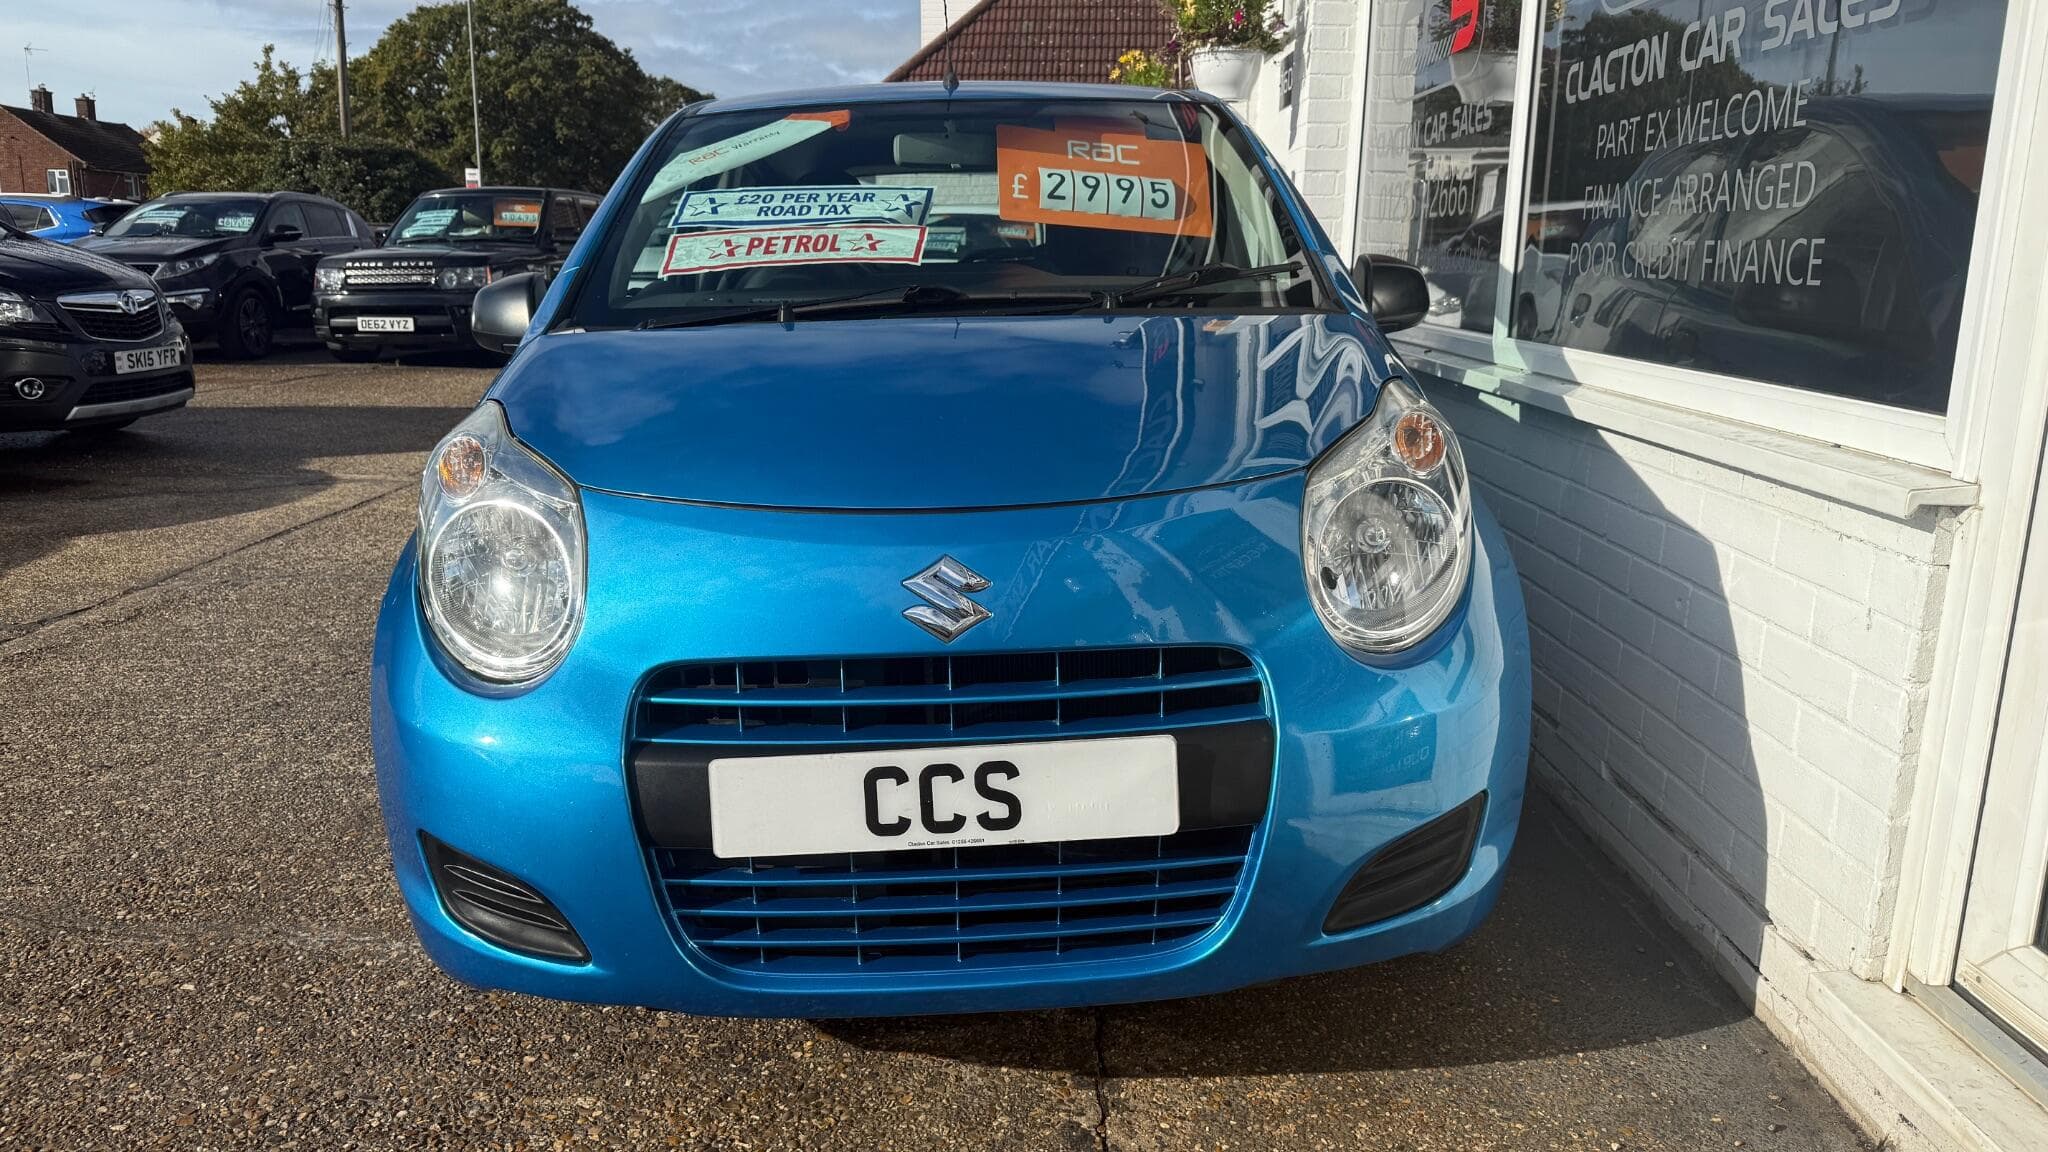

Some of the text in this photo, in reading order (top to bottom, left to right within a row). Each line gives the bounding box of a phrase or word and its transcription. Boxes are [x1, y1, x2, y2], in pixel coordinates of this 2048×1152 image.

[1565, 32, 1669, 104] CLACTON
[1680, 6, 1746, 72] CAR
[1423, 111, 1448, 146] CAR
[1451, 98, 1493, 140] SALES
[1596, 78, 1812, 160] PART EX WELCOME
[734, 192, 876, 206] £20 PER YEAR
[757, 204, 854, 217] ROAD TAX
[1583, 160, 1817, 221] FINANCE ARRANGED
[745, 234, 841, 257] PETROL
[1568, 237, 1826, 286] POOR CREDIT FINANCE
[389, 319, 409, 330] VYZ
[127, 348, 177, 369] SK15 YFR
[863, 760, 1022, 837] CCS
